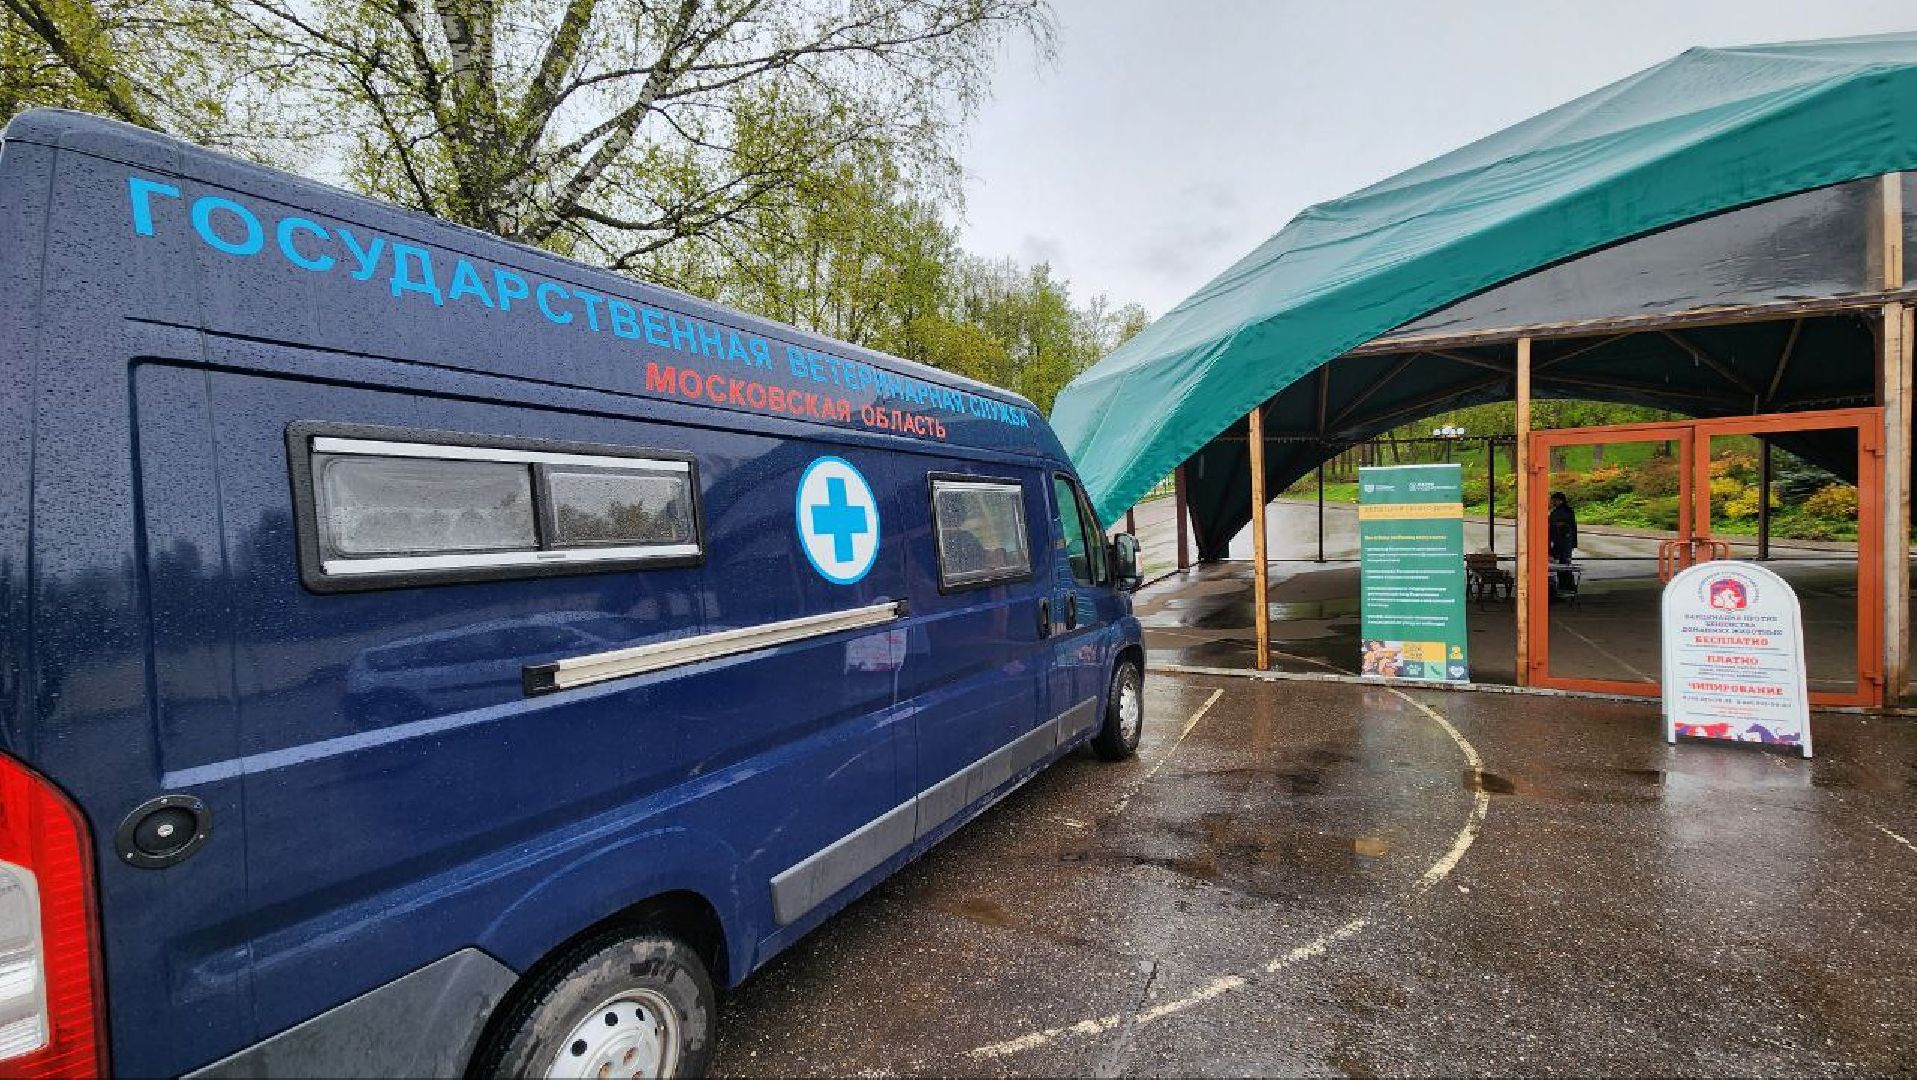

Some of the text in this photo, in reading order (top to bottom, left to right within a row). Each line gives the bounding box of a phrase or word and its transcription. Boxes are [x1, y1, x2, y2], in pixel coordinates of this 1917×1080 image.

[129, 177, 1030, 429] ГОСУДАРСТВЕННАЯ ВЕТЕРИНАРНАЯ СЛУЖБА
[645, 362, 947, 440] МОСКОВСКАЯ ОБЛАСТЬ
[1694, 635, 1769, 647] БЕСПЛАТНО
[1706, 655, 1759, 666] ПЛАТНО
[1688, 682, 1784, 696] ЧИПИРОВАНИЕ
